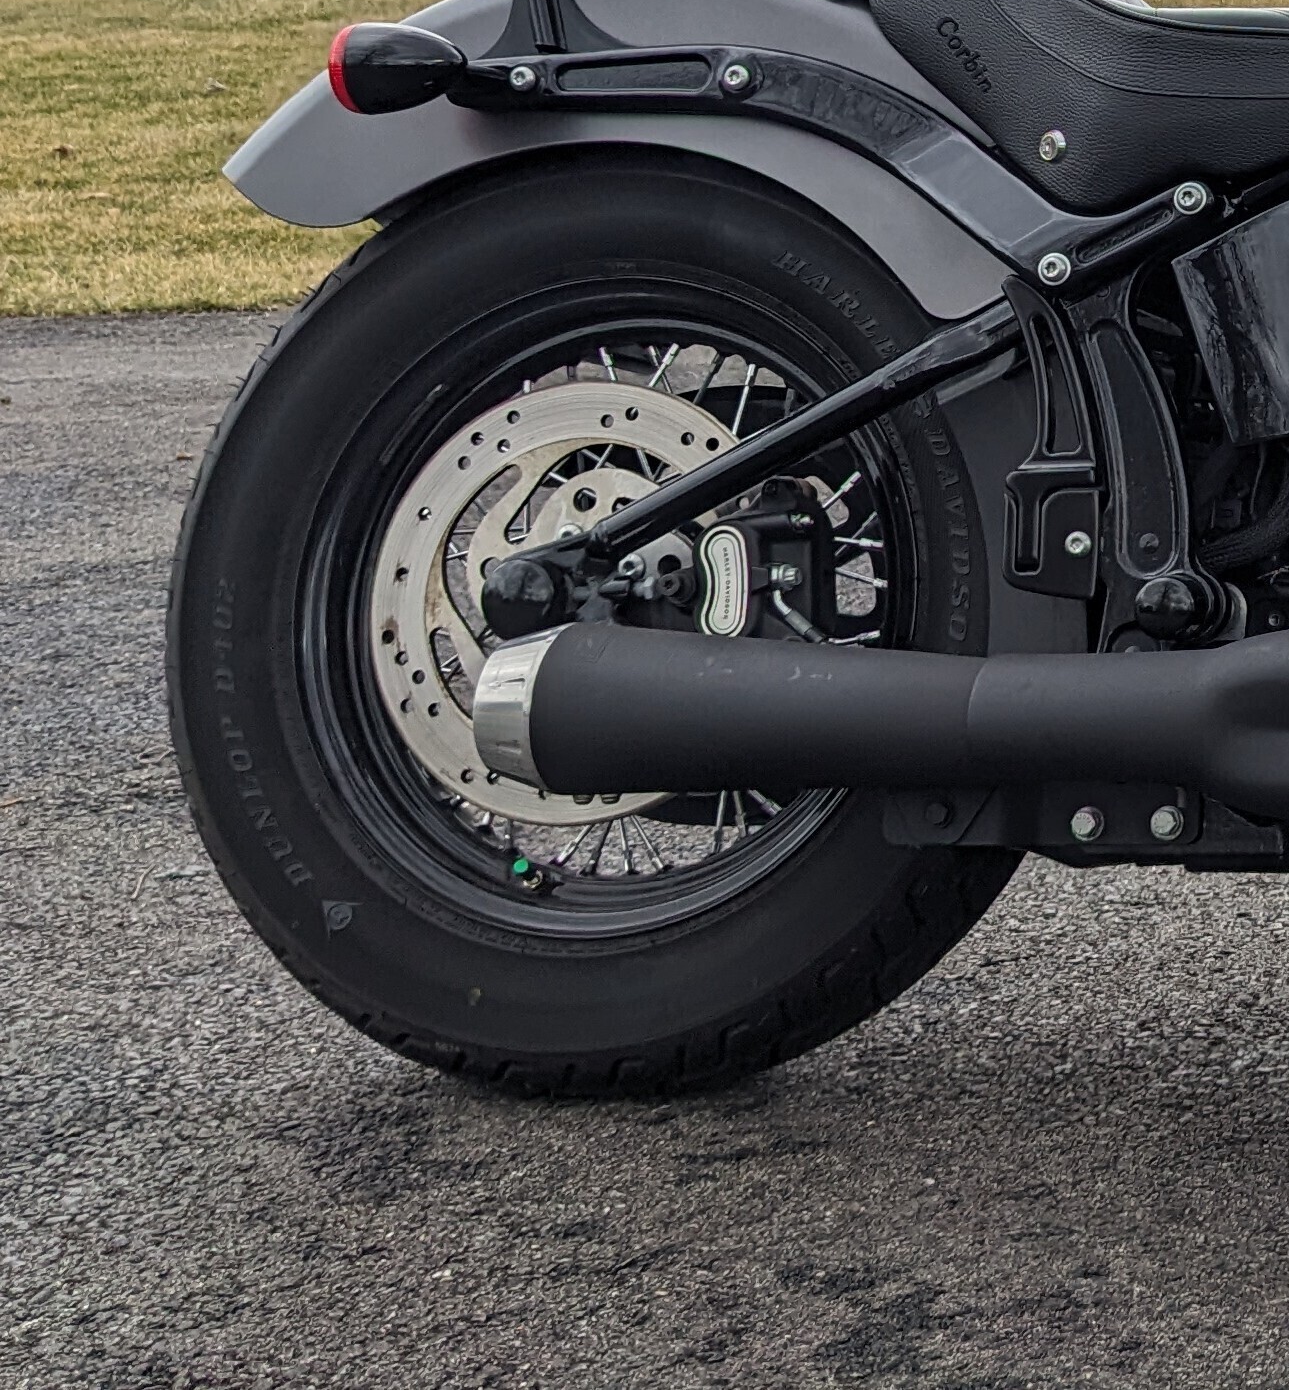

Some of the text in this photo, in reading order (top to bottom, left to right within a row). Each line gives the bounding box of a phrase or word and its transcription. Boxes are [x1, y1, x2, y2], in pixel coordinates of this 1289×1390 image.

[936, 16, 992, 94] Corbin
[771, 250, 971, 642] HARLE DAVIDSO
[722, 546, 732, 620] HARLEY-DAVIDSON
[219, 714, 313, 887] DUNLOP
